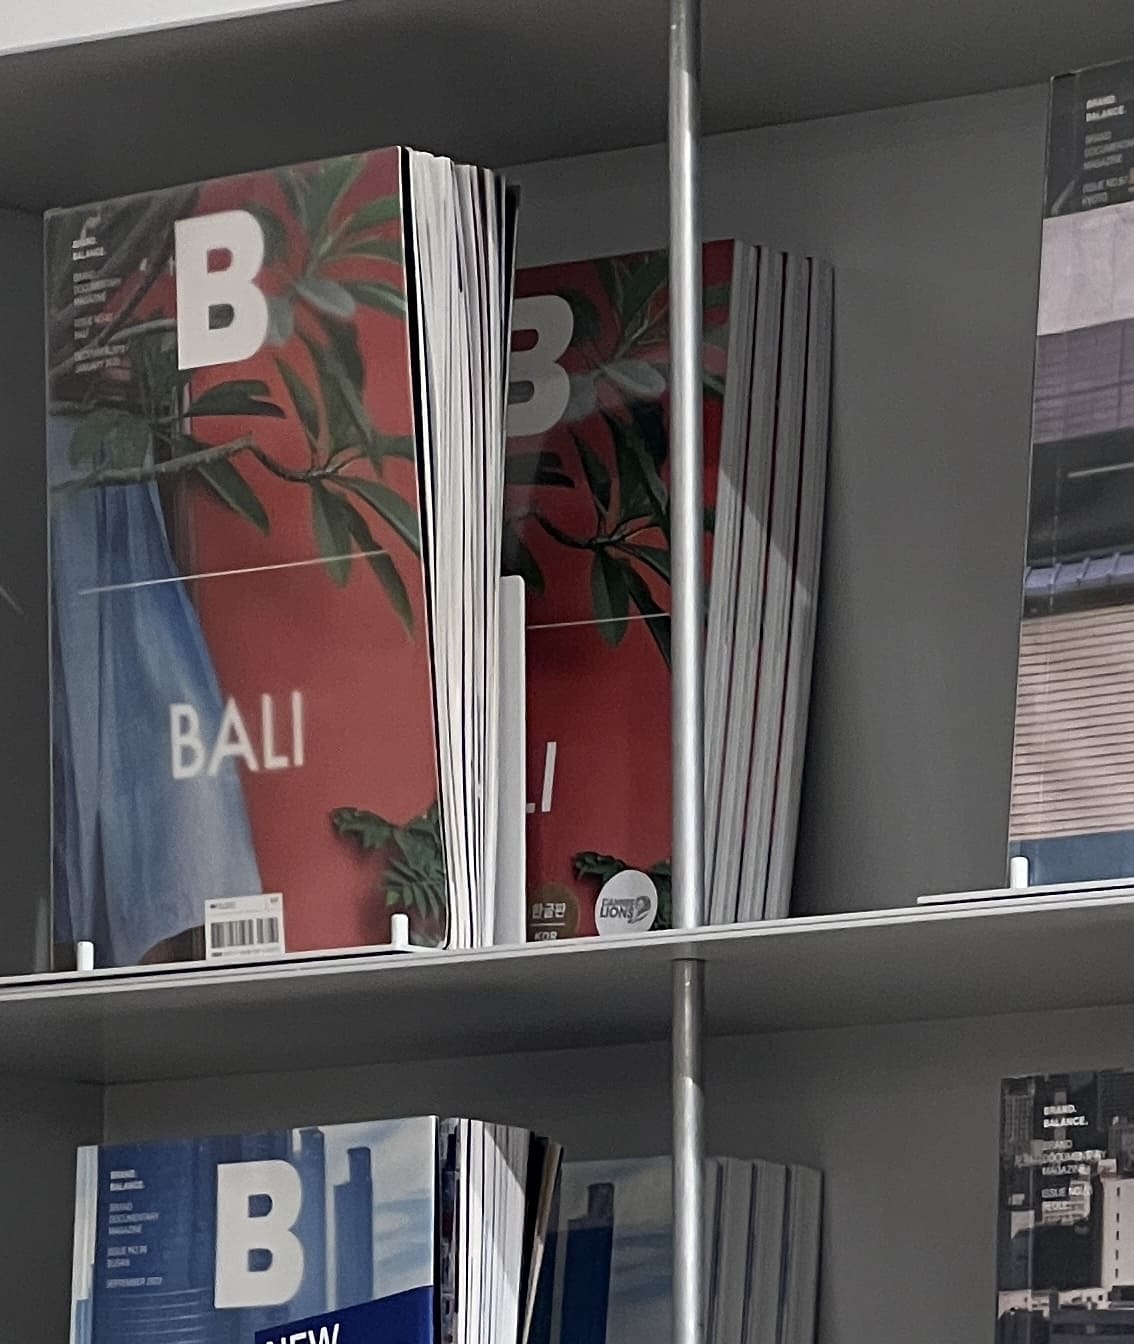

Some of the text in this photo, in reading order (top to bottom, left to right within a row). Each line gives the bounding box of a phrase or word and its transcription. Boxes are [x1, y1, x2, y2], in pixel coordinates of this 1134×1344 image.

[174, 209, 269, 371] B
[169, 690, 304, 780] BALI
[214, 1159, 304, 1309] B
